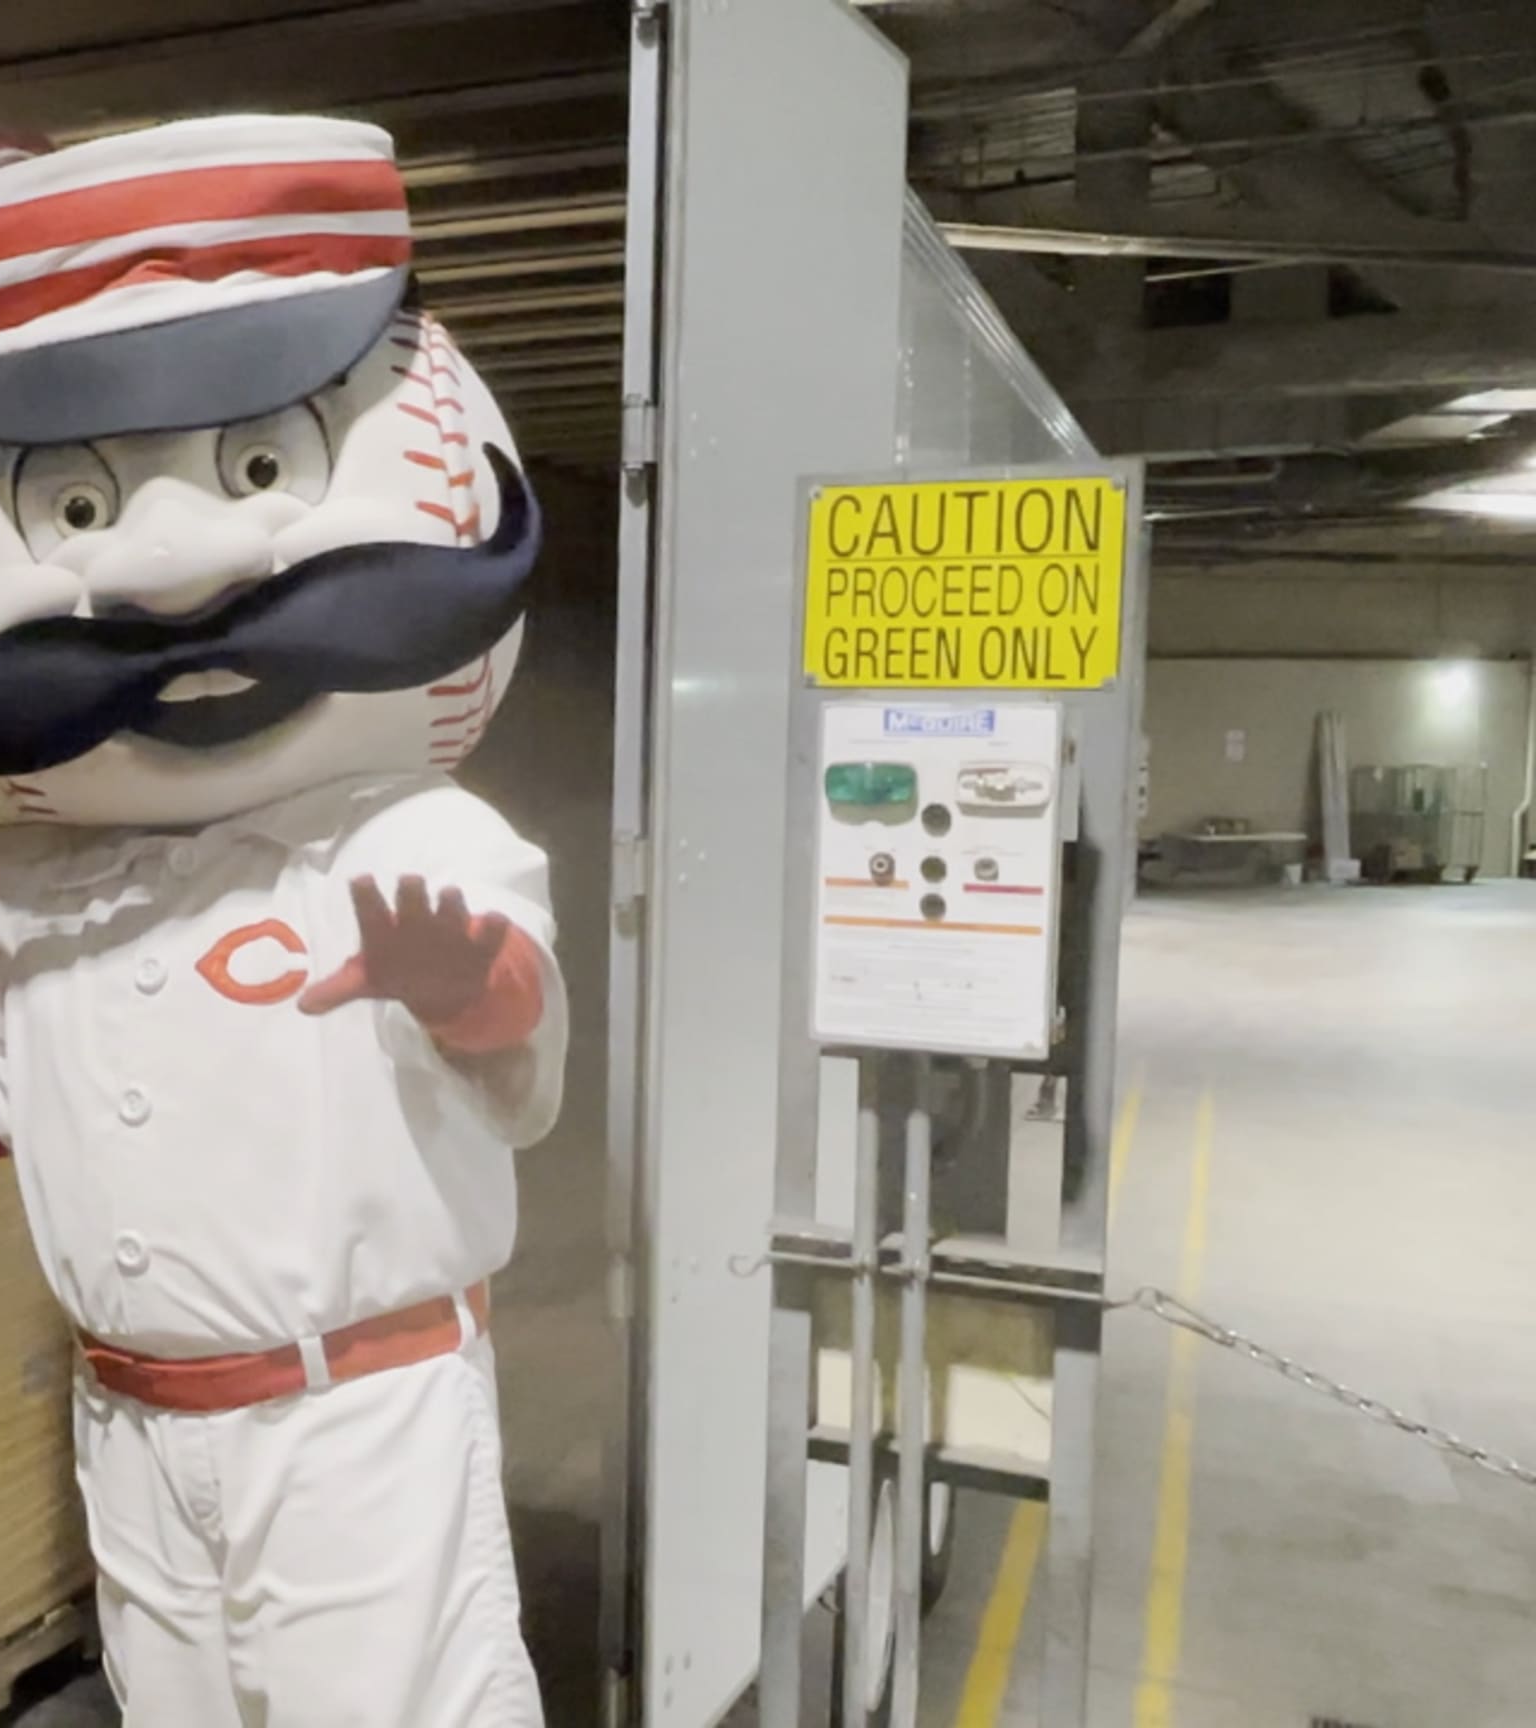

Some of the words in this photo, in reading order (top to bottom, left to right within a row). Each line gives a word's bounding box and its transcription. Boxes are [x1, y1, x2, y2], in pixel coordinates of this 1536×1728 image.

[827, 487, 1103, 557] CAUTION
[825, 564, 1024, 618] PROCEED
[1038, 563, 1100, 617] ON
[823, 626, 962, 680] GREEN
[979, 625, 1099, 680] ONLY
[194, 918, 308, 1006] C
